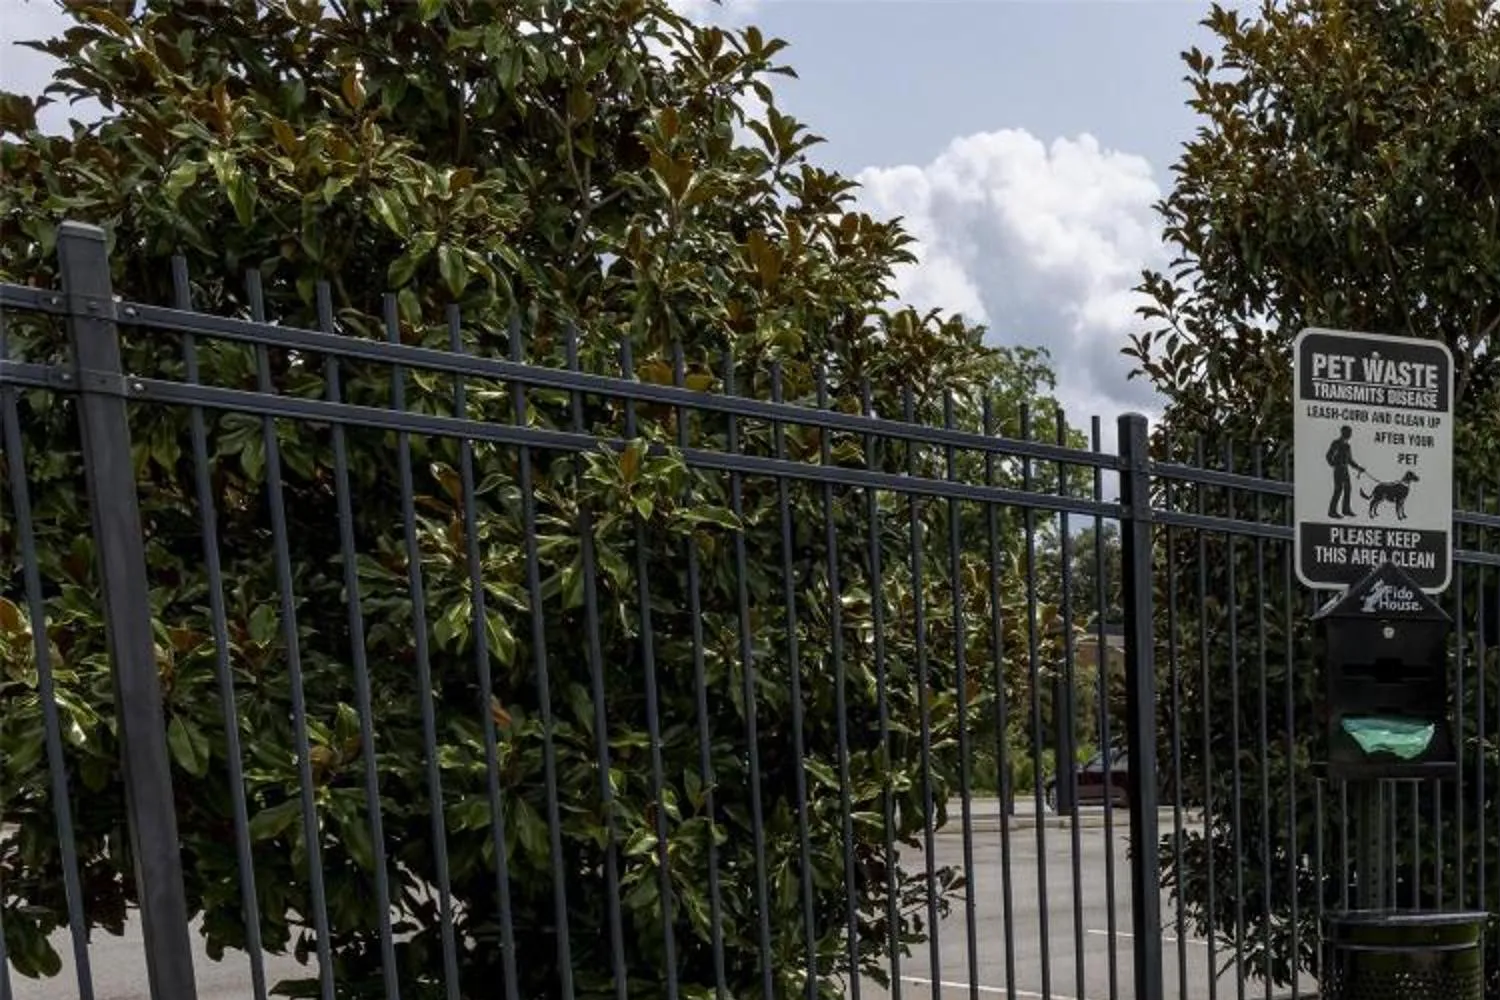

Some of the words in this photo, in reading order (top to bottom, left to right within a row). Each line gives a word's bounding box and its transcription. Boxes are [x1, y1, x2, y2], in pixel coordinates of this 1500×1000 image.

[1312, 352, 1356, 380] PET
[1362, 357, 1438, 389] WASTE
[1314, 382, 1385, 400] TRANSMITS
[1388, 389, 1438, 408] DISEASE
[1307, 405, 1369, 422] LEASH-CURB
[1371, 411, 1391, 424] AND
[1394, 413, 1425, 428] CLEAN
[1427, 417, 1441, 429] UP
[1374, 431, 1405, 445] AFTER
[1409, 434, 1435, 448] YOUR
[1397, 453, 1418, 466] PET
[1330, 527, 1383, 547] PLEASE
[1386, 532, 1421, 549] KEEP
[1314, 546, 1347, 563] THIS
[1351, 549, 1387, 566] AREA
[1391, 551, 1436, 569] CLEAN
[1384, 585, 1413, 600] Fido
